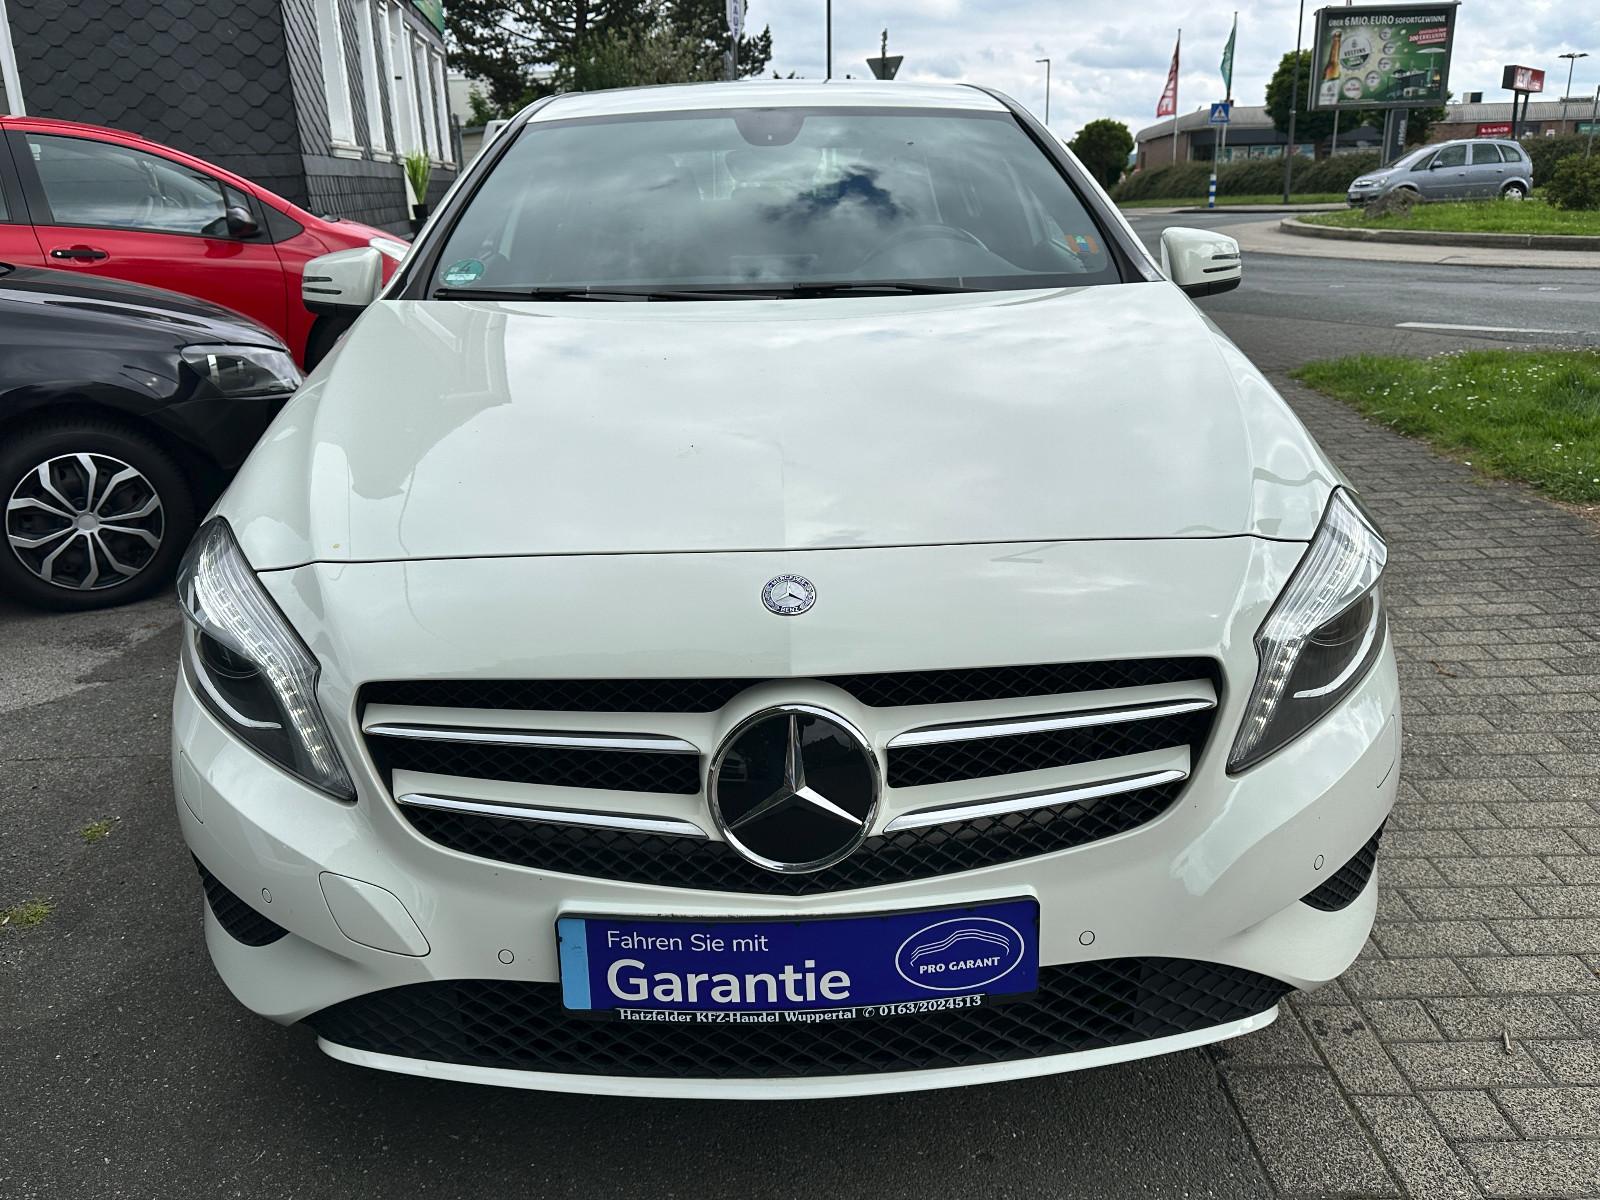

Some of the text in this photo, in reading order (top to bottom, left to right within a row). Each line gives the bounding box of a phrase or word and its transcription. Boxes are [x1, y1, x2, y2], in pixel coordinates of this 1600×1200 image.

[1344, 17, 1350, 26] 6
[1350, 16, 1370, 25] MIO.
[1370, 15, 1394, 25] EURO
[1395, 15, 1446, 25] SOFORTGEWINNE
[607, 930, 768, 952] Fahren Sie mit
[919, 957, 1000, 974] PRO GARANT
[607, 958, 851, 1003] Garantie
[620, 995, 981, 1023] Hatzfelder KFZ-Handel Wuppertal 0163/2024513
